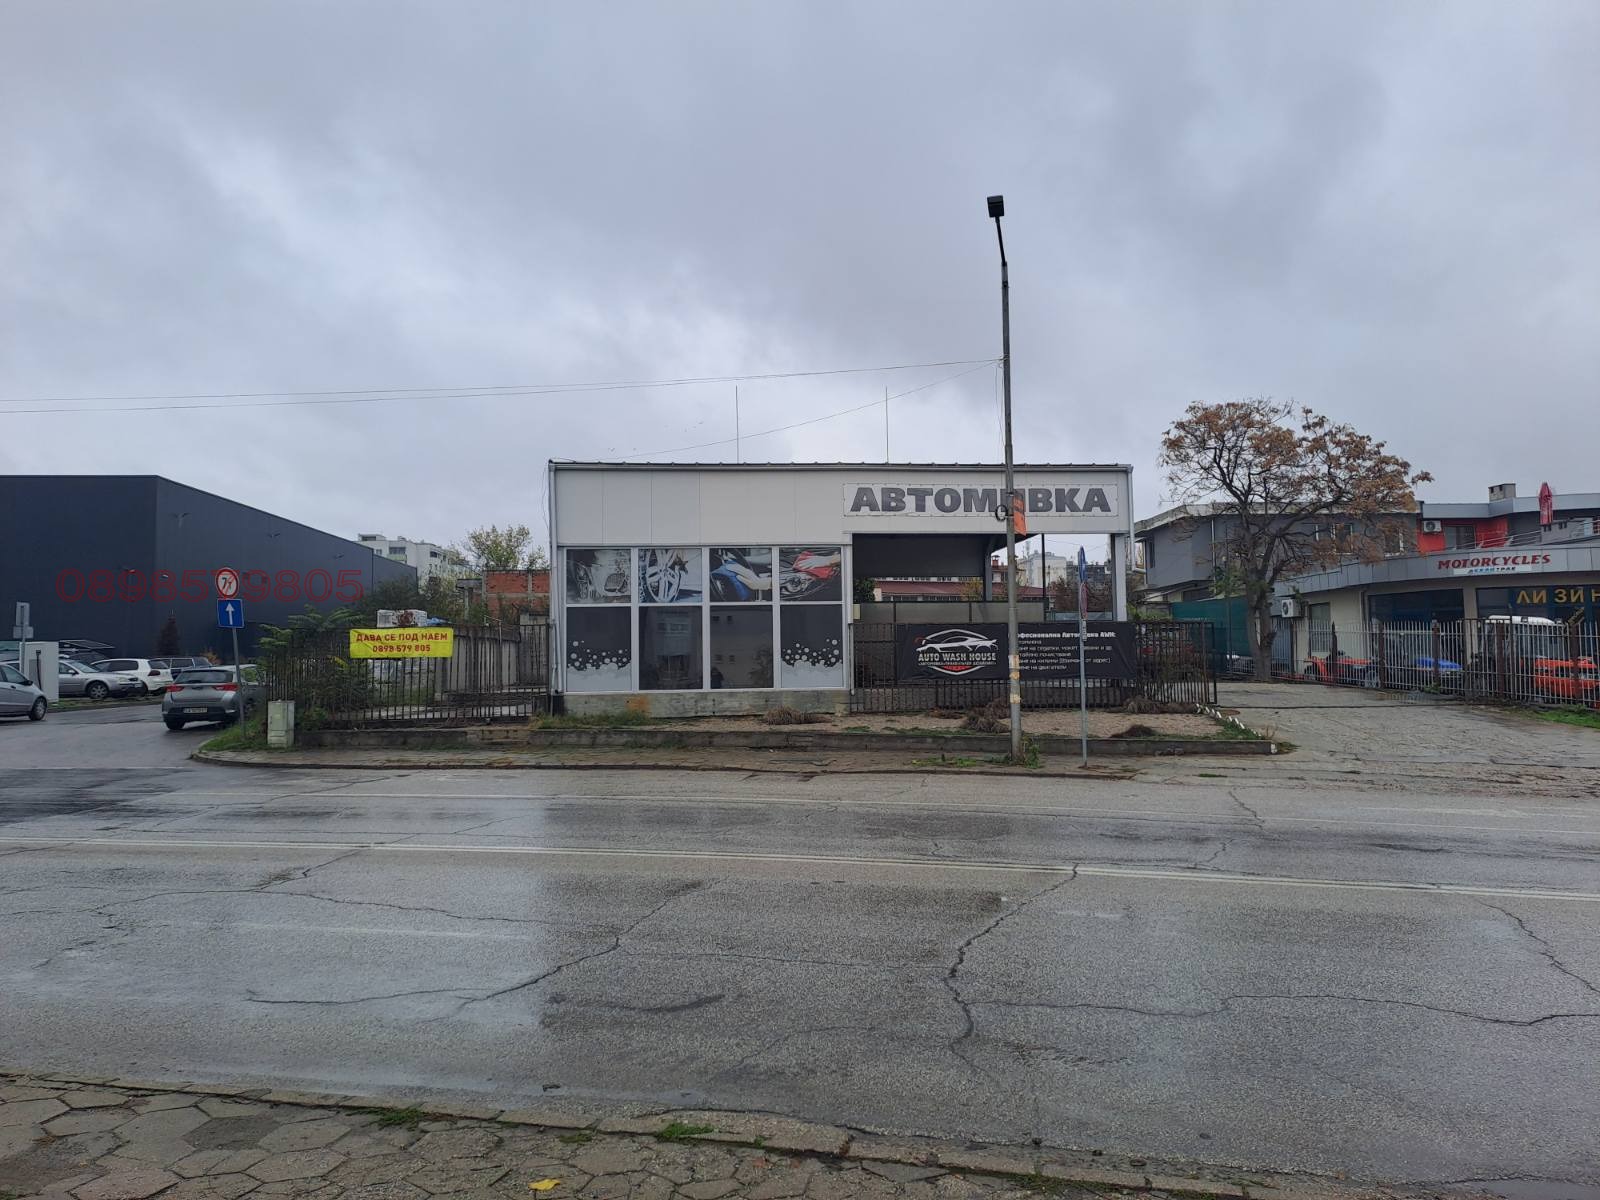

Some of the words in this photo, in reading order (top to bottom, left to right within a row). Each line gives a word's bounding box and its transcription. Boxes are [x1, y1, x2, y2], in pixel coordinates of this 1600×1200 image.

[1438, 554, 1551, 570] MOTORCYCLES
[356, 634, 382, 642] ДАВА
[399, 633, 418, 642] ПОД
[421, 633, 448, 641] НАЕМ
[397, 645, 412, 653] 579
[415, 644, 431, 652] 805
[918, 653, 940, 661] AUTO
[942, 653, 967, 661] WASH
[969, 652, 997, 661] HOUSE
